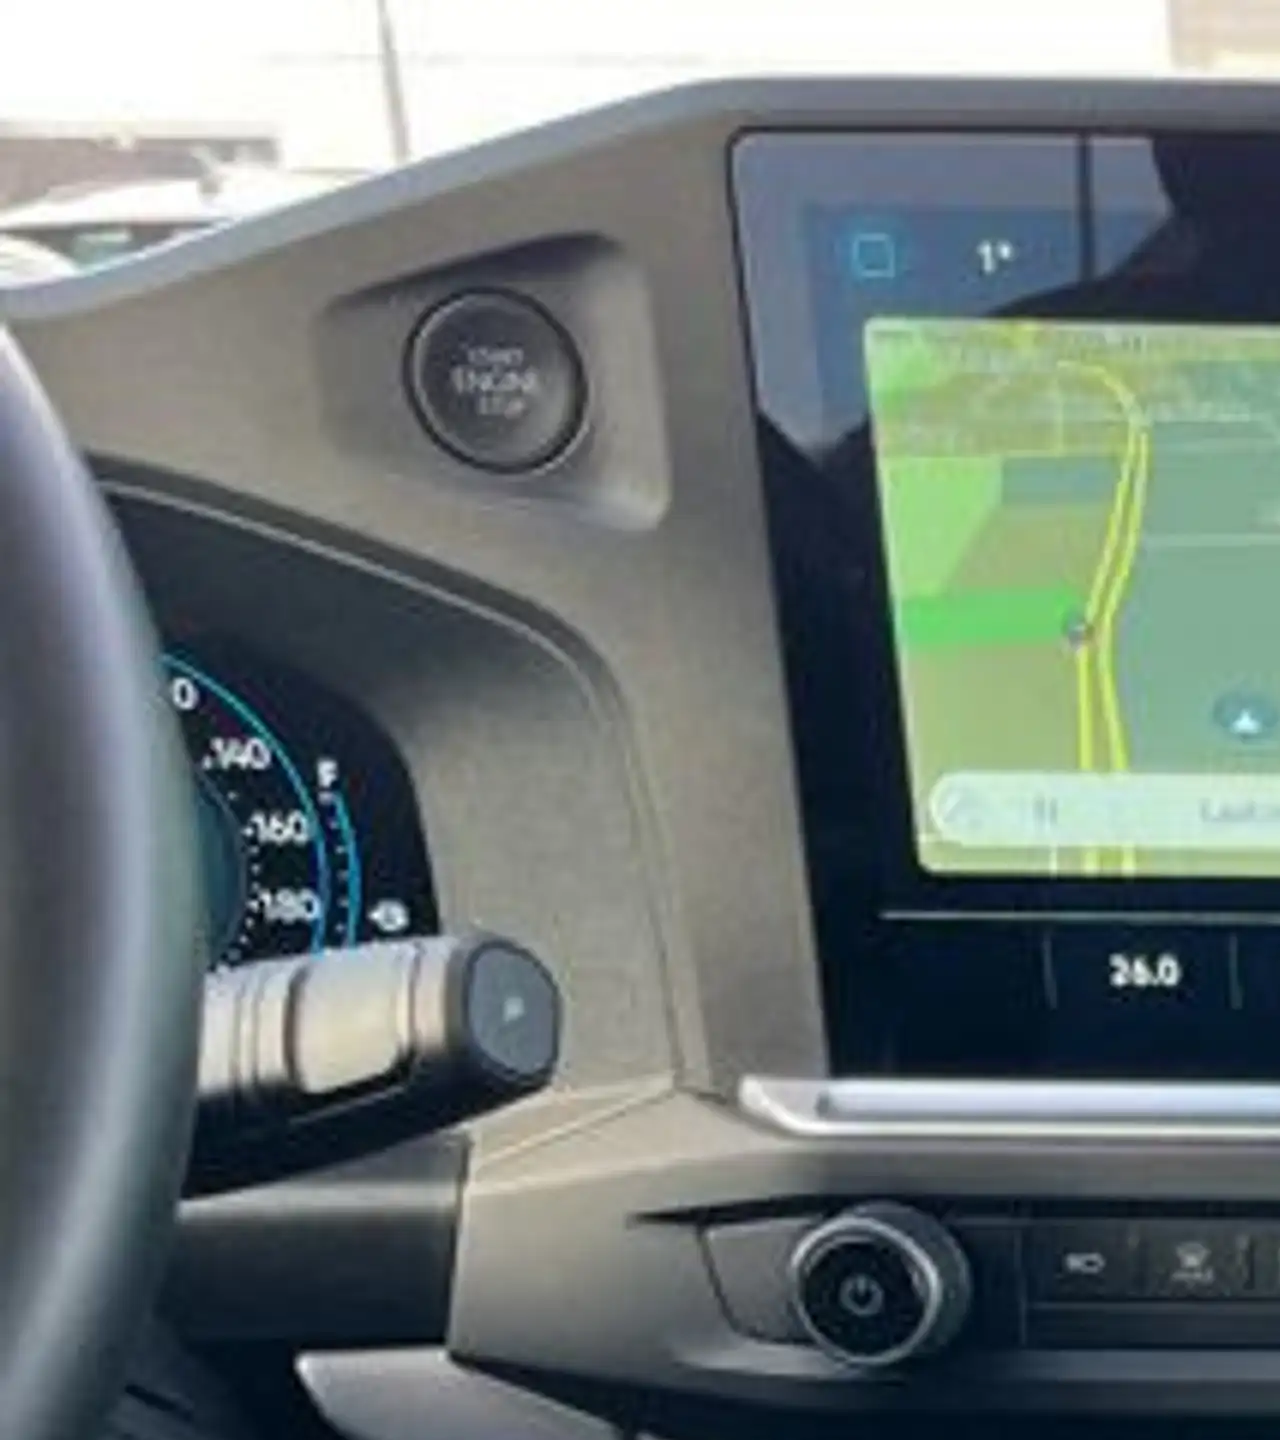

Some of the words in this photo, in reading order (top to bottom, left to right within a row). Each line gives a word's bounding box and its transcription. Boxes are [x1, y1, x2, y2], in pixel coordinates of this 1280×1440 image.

[252, 808, 310, 846] 160
[258, 887, 322, 924] 180
[1109, 954, 1182, 987] 26.0
